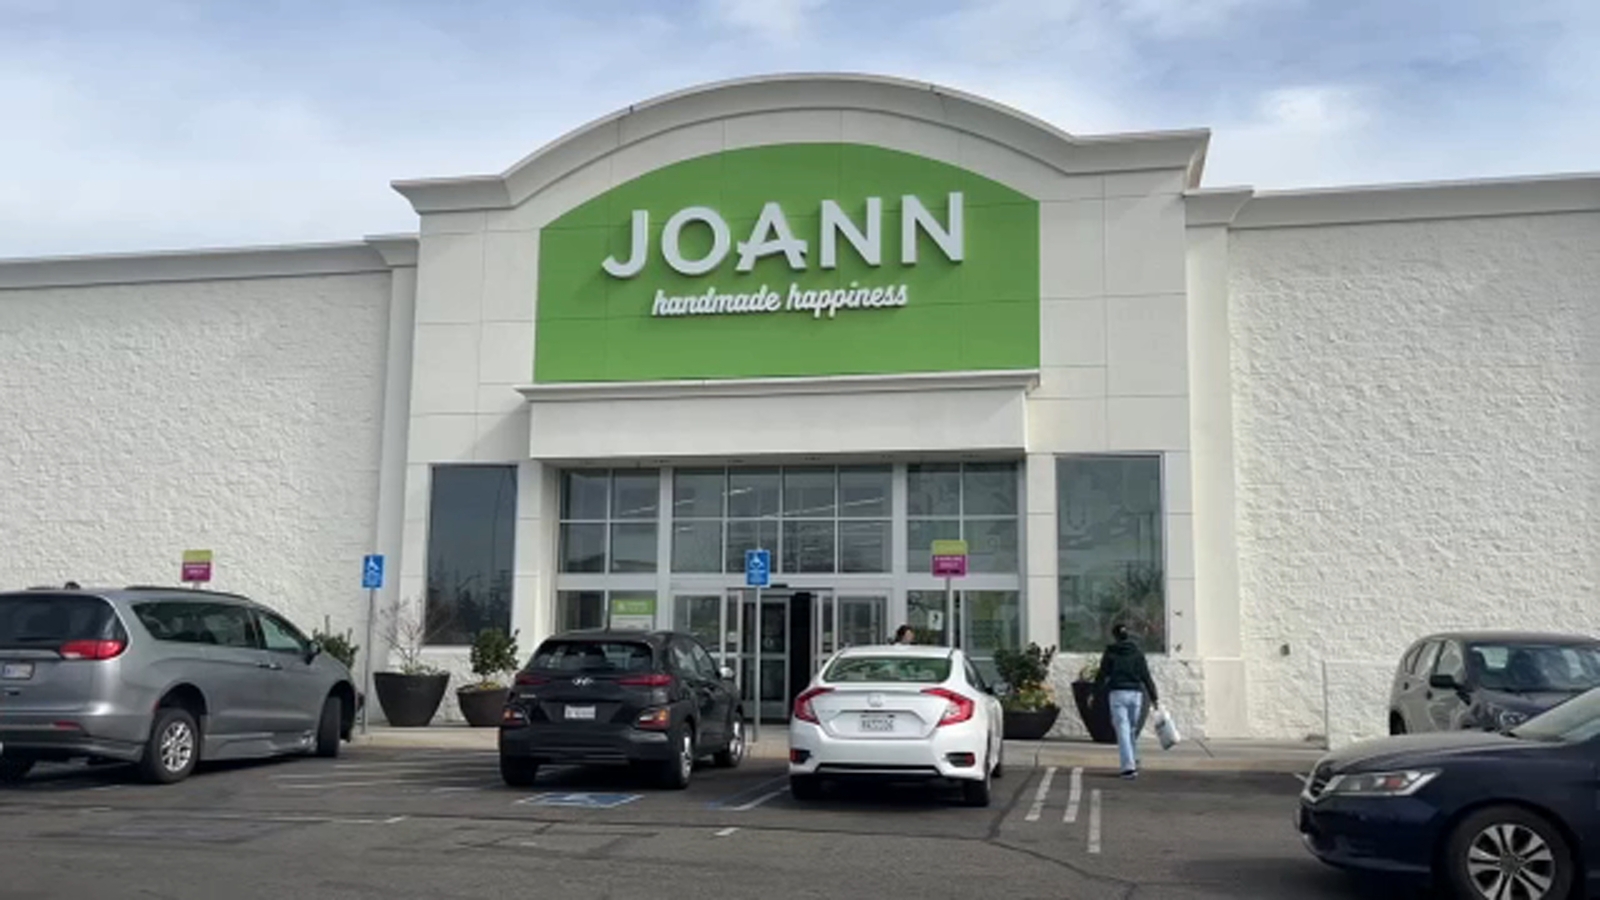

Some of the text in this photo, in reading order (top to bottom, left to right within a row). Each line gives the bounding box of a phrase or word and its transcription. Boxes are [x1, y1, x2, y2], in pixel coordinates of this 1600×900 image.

[602, 191, 965, 278] JOANN
[651, 282, 909, 318] handmade happiness
